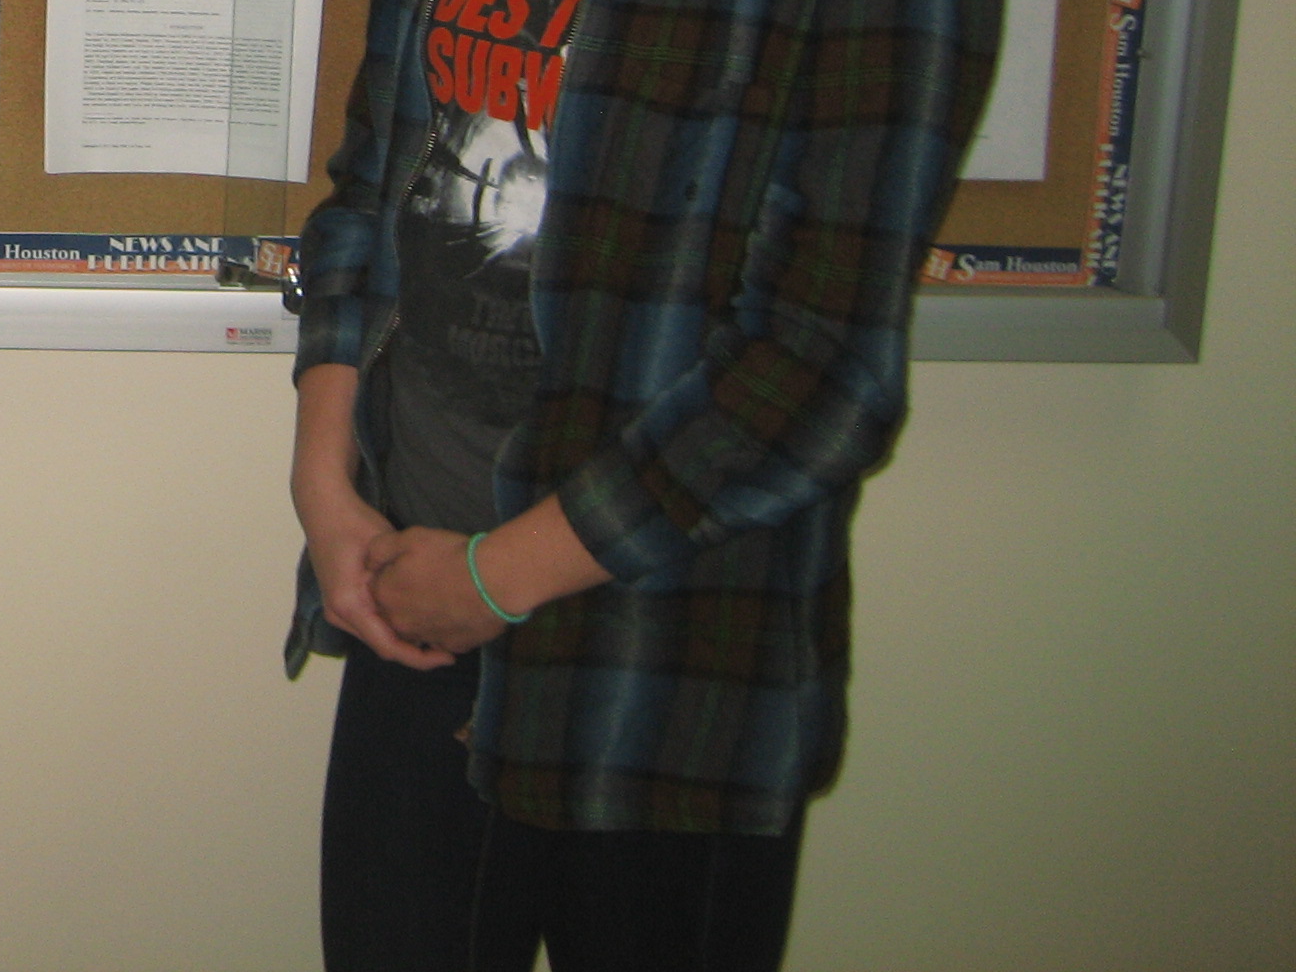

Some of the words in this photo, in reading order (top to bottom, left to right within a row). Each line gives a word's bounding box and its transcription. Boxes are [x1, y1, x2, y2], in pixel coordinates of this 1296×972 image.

[1108, 62, 1132, 138] Houston
[4, 243, 81, 261] Houston
[108, 236, 173, 253] NEWS
[180, 237, 225, 253] AND
[956, 253, 1002, 282] Sam
[1006, 255, 1079, 273] Houston
